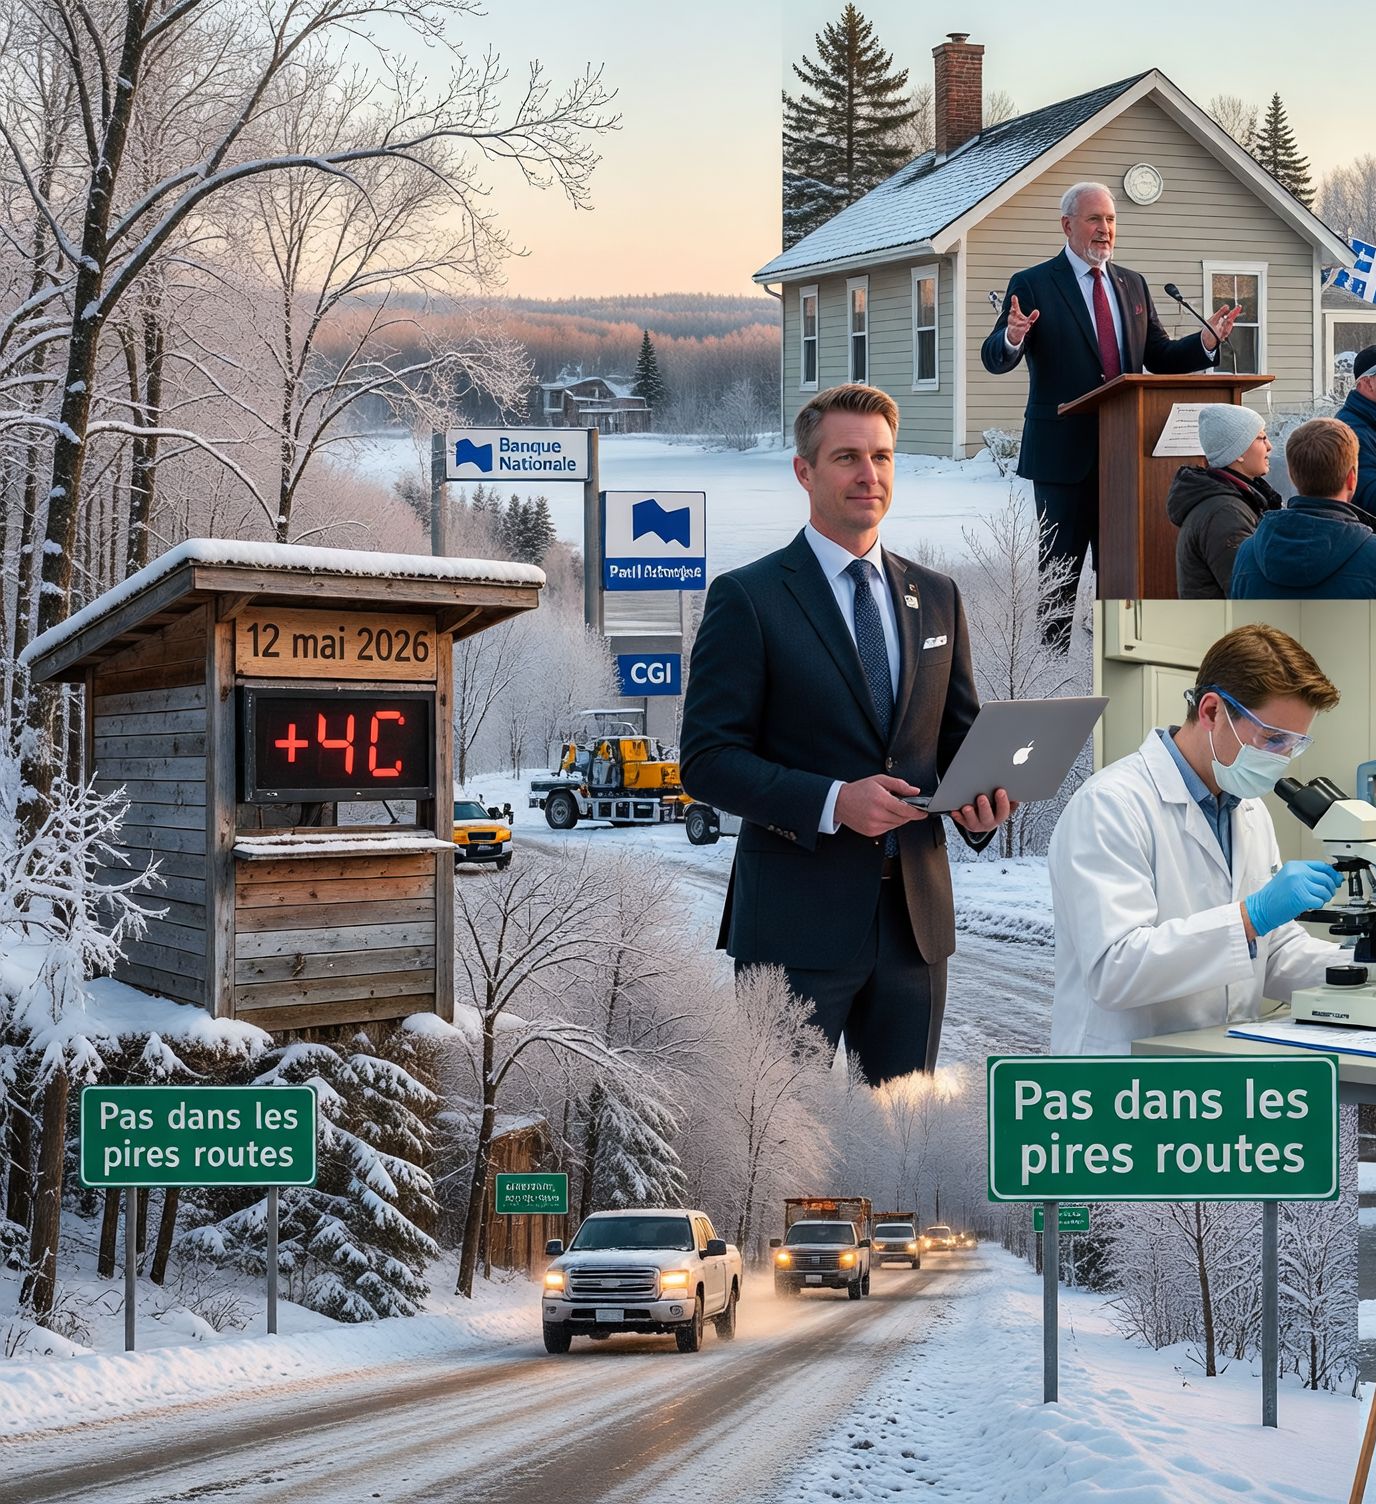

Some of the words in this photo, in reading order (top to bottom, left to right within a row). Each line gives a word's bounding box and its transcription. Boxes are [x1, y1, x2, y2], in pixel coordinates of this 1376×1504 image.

[499, 437, 562, 456] Banque
[499, 455, 577, 471] Nationale
[247, 622, 280, 658] 12
[292, 625, 345, 660] mai
[357, 627, 429, 662] 2026
[630, 662, 672, 684] CGI
[100, 1101, 154, 1130] Pas
[167, 1101, 241, 1130] dans
[255, 1101, 298, 1130] les
[1014, 1079, 1093, 1121] Pas
[1114, 1078, 1223, 1120] dans
[1246, 1078, 1309, 1119] les
[104, 1138, 180, 1177] pires
[194, 1141, 294, 1168] routes
[1021, 1132, 1134, 1186] pires
[1156, 1134, 1305, 1174] routes
